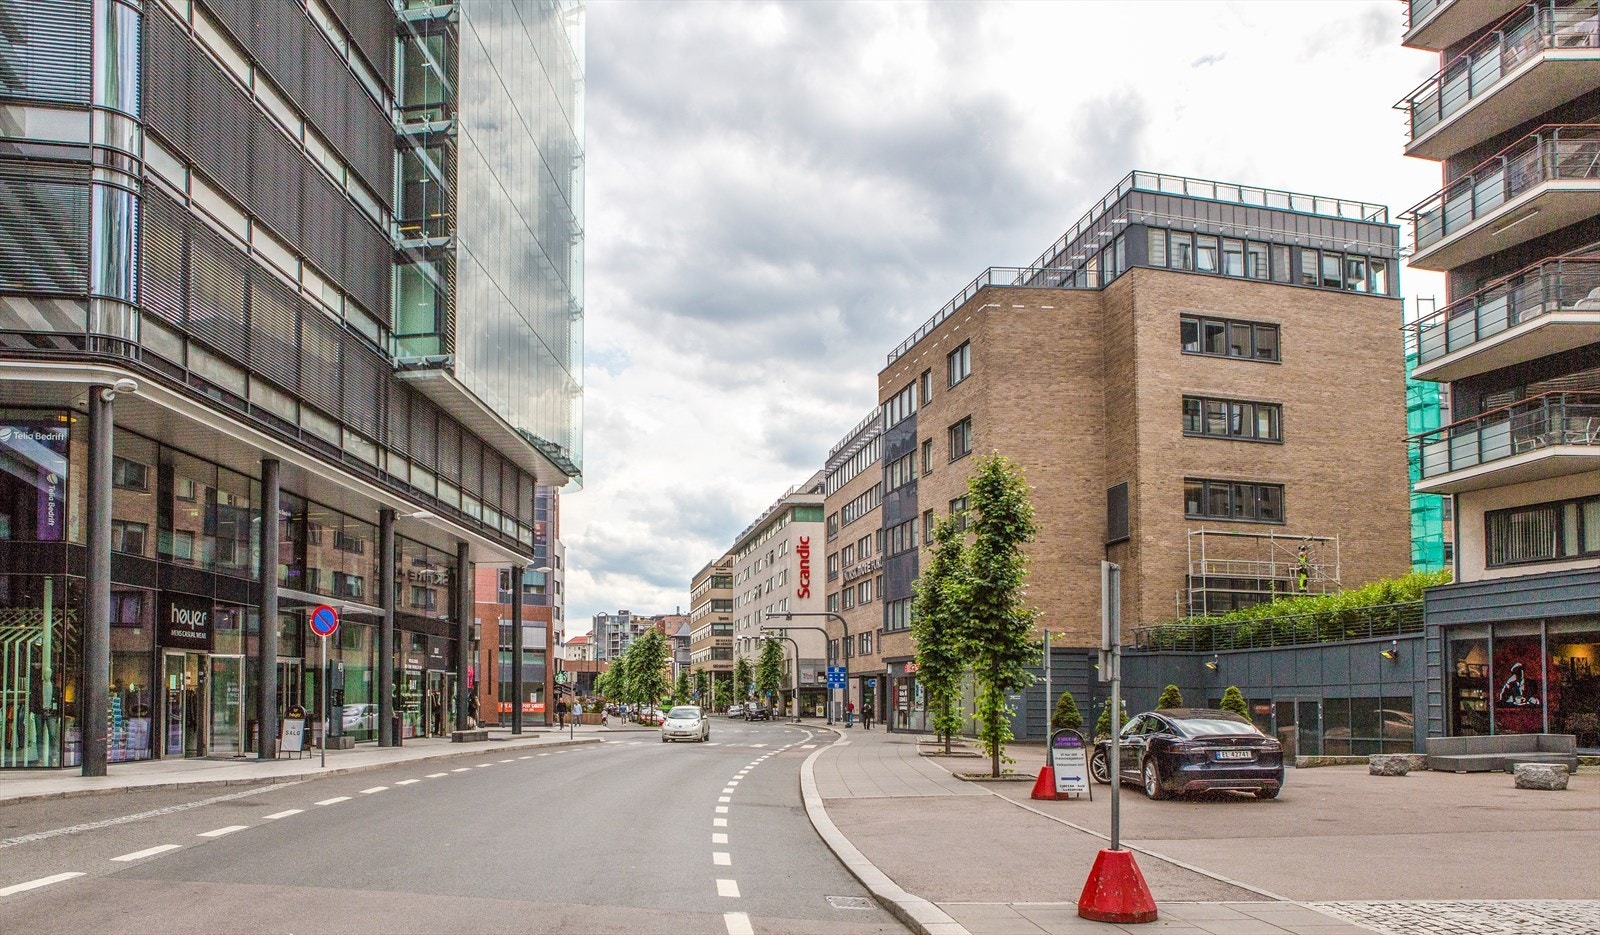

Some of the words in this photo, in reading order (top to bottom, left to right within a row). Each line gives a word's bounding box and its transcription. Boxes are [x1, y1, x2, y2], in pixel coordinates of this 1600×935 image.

[13, 431, 34, 440] Telia
[35, 432, 65, 441] Bedrift
[48, 485, 56, 501] Telia
[48, 501, 56, 526] Bedrift
[796, 535, 811, 599] Scandic
[171, 602, 208, 630] høyer
